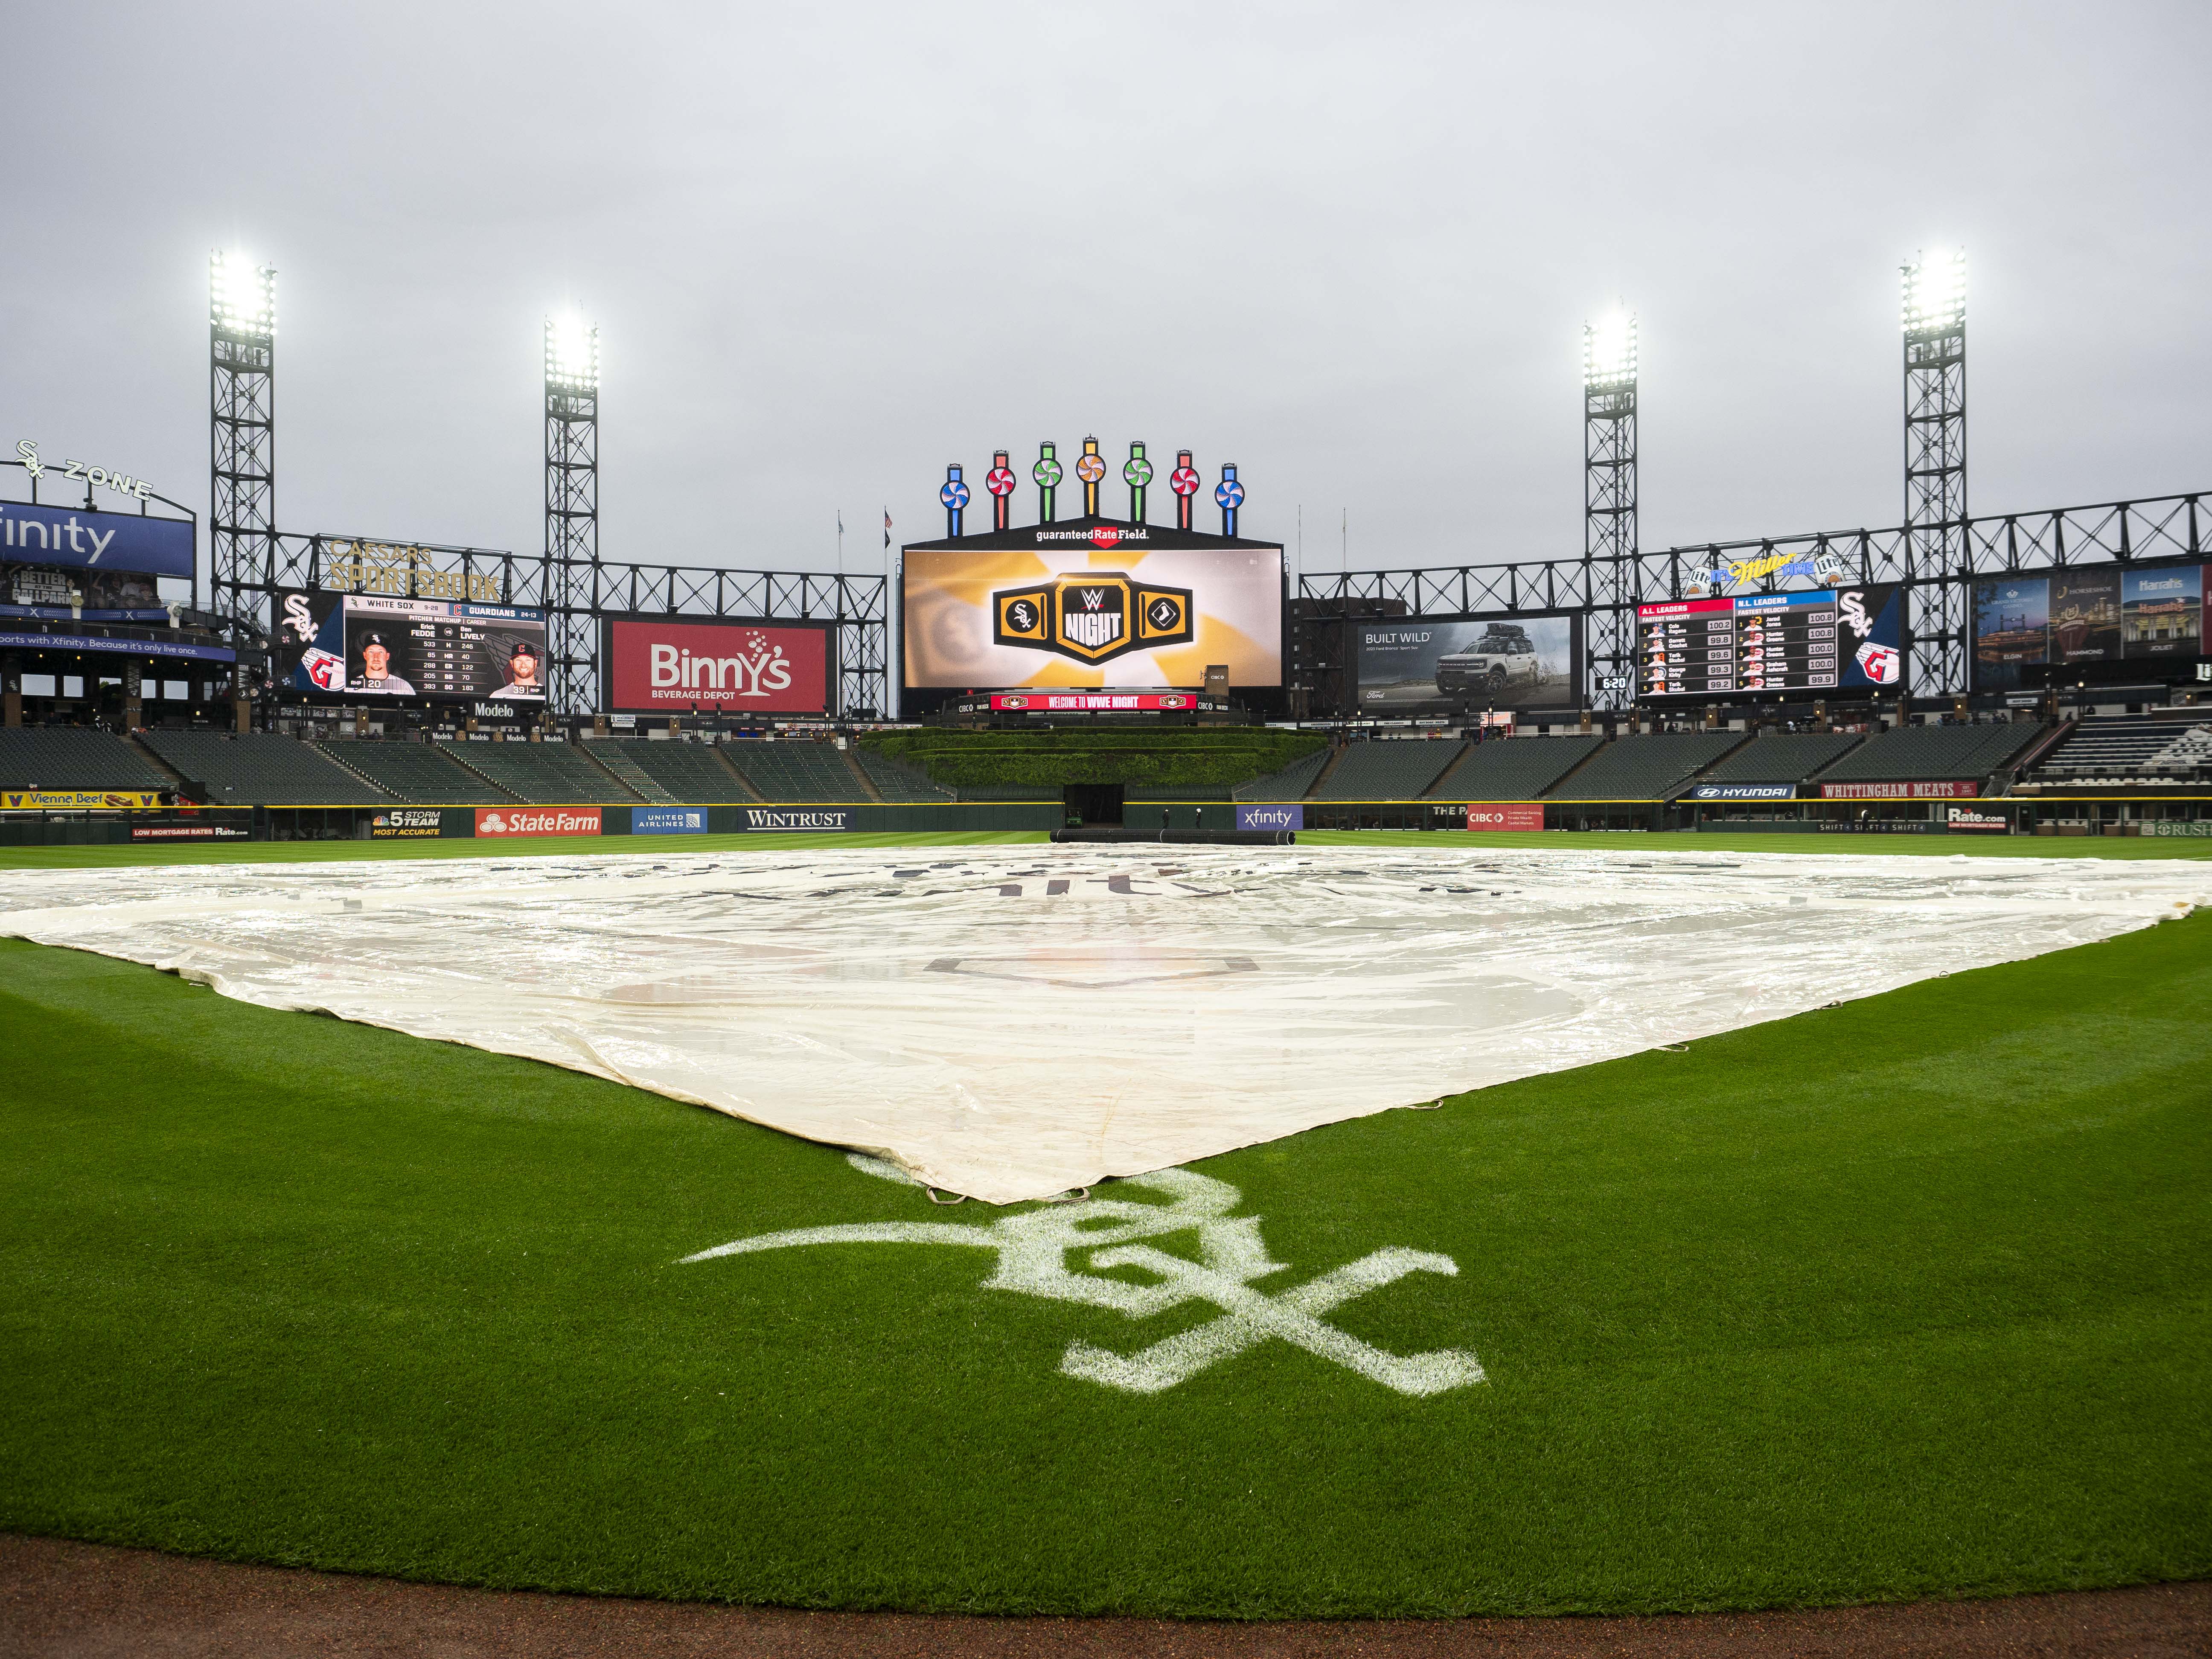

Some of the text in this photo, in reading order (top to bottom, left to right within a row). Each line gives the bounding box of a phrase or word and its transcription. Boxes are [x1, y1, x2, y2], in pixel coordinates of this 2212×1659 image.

[64, 460, 153, 501] ZONE
[1036, 530, 1093, 541] guaranteed
[1094, 530, 1117, 539] Rate
[330, 540, 432, 565] CAESARS
[1729, 553, 1797, 586] Miller
[1781, 562, 1814, 576] TIME
[1816, 558, 1838, 574] Lite
[21, 570, 66, 585] BETTER
[330, 562, 501, 602] SPORTSBOOK
[1691, 571, 1711, 584] Lite
[2139, 578, 2183, 591] Harrah's
[367, 600, 394, 608] WHITE
[397, 601, 414, 609] SOX
[1754, 597, 1787, 605] LEADERS
[469, 607, 515, 617] GUARDIANS
[1657, 605, 1688, 613] LEADERS
[1065, 613, 1121, 646] NIGHT
[1366, 633, 1397, 643] BUILT
[52, 637, 86, 648] Xfinity.
[90, 639, 128, 649] Because
[130, 642, 142, 650] it's
[144, 644, 161, 653] only
[368, 680, 381, 688] 20
[1603, 678, 1626, 689] 6:20
[652, 690, 735, 700] BEVERAGE DEPOT
[1048, 696, 1138, 708] WELCOME TO WWE NIGHT
[475, 703, 513, 717] Modelo
[1723, 788, 1787, 796] HYUNDAI
[1824, 783, 1954, 797] WHITTINGHAM MEATS
[29, 794, 102, 803] Vienna Beef
[390, 812, 403, 827] 5
[1245, 809, 1292, 827] xfinity
[1470, 813, 1492, 823] CIBC
[1949, 808, 2005, 822] Rate.com
[215, 827, 247, 835] Rate.com
[2172, 824, 2212, 835] RUSH
